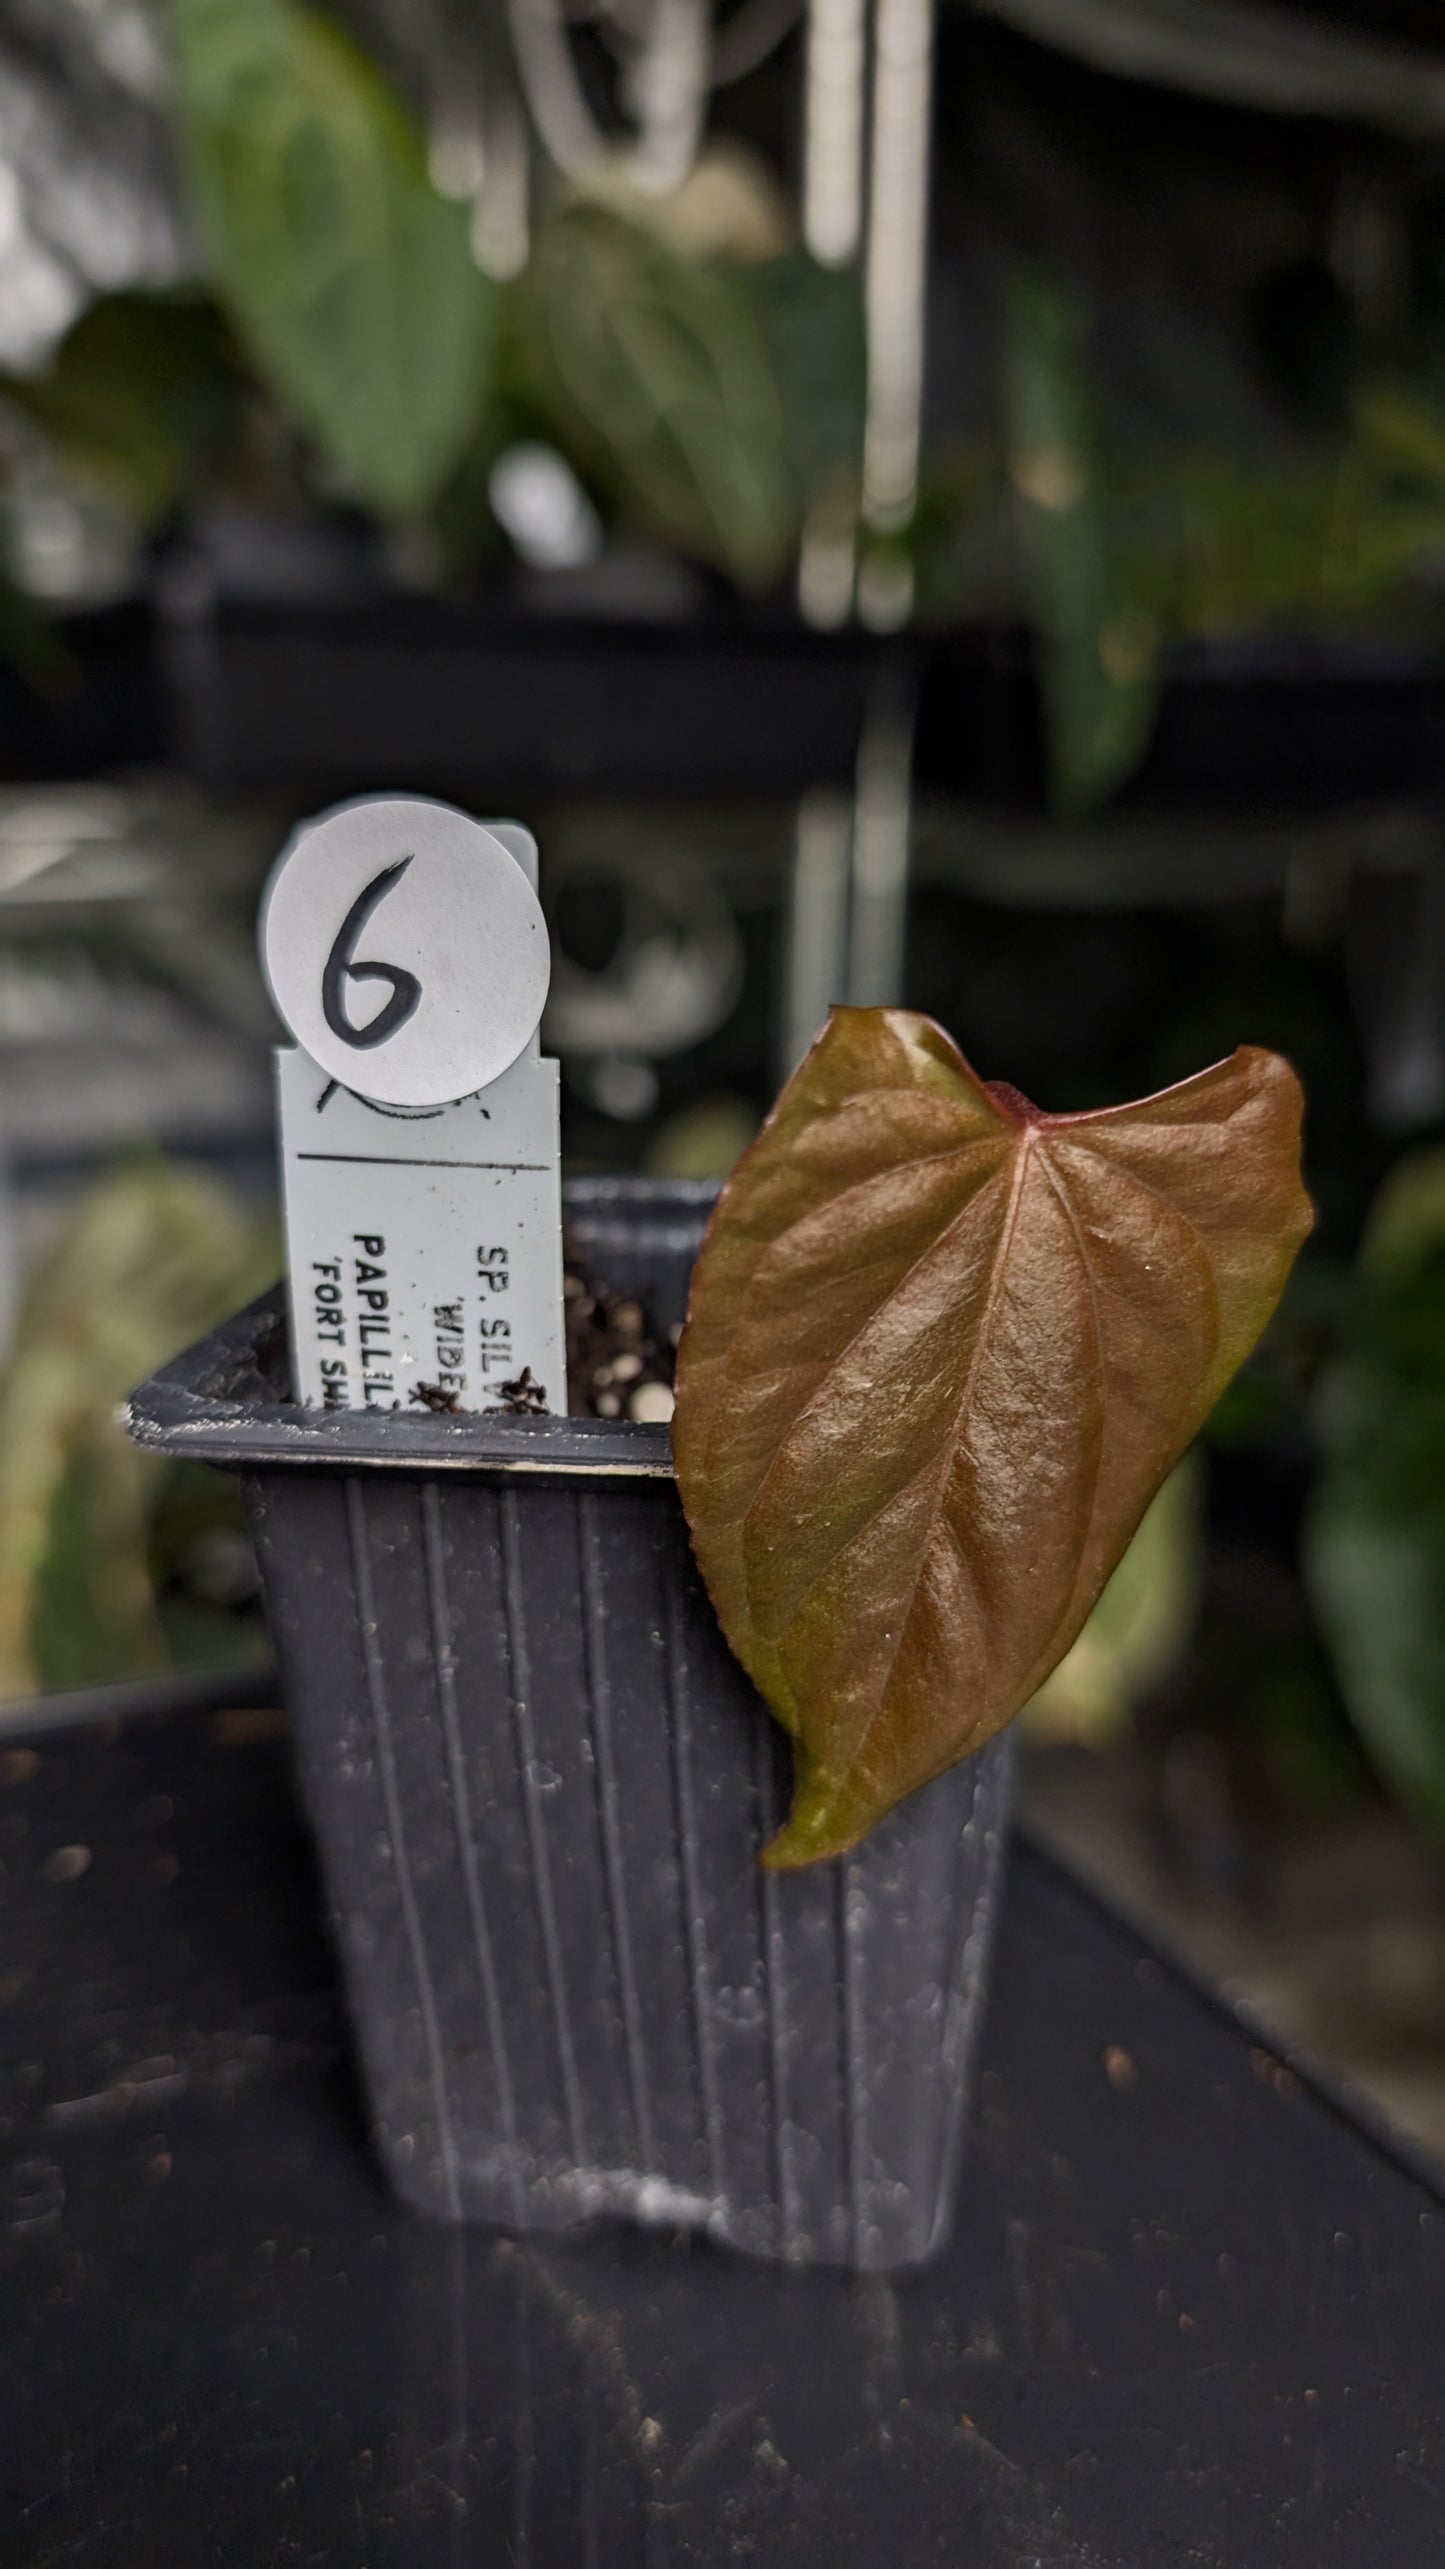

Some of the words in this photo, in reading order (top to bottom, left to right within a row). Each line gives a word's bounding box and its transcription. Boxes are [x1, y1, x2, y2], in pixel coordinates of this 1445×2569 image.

[322, 854, 422, 1051] 6
[353, 1234, 395, 1407] PAPILLIL
[477, 1245, 509, 1302] SP.
